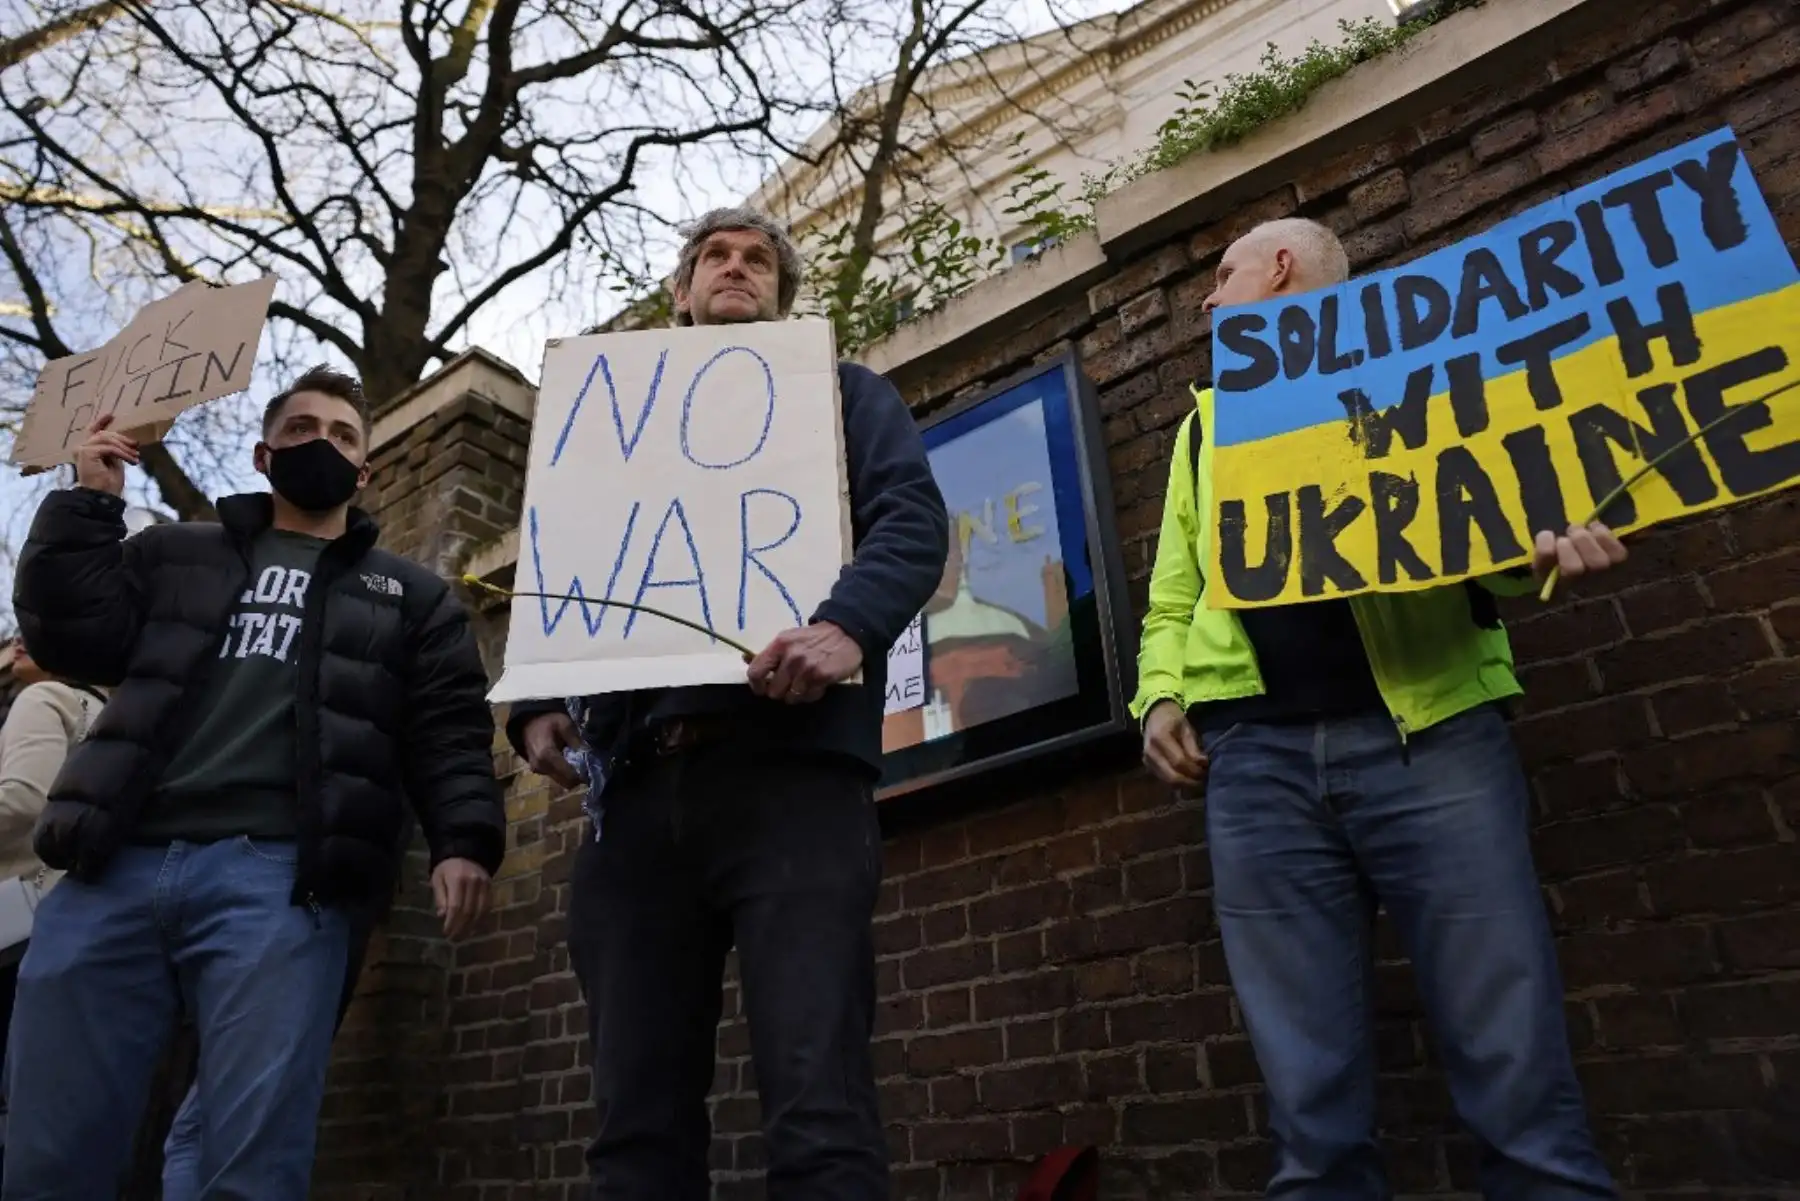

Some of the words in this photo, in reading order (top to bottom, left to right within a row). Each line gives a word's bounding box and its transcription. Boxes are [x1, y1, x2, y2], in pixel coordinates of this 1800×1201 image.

[1217, 141, 1750, 392] SOLIDARITY
[62, 310, 194, 408] FUCK
[62, 342, 246, 449] PUTIN
[549, 345, 776, 470] NO
[1338, 281, 1702, 459] WITH
[1219, 345, 1800, 601] UKRAINE
[530, 488, 802, 644] WAR
